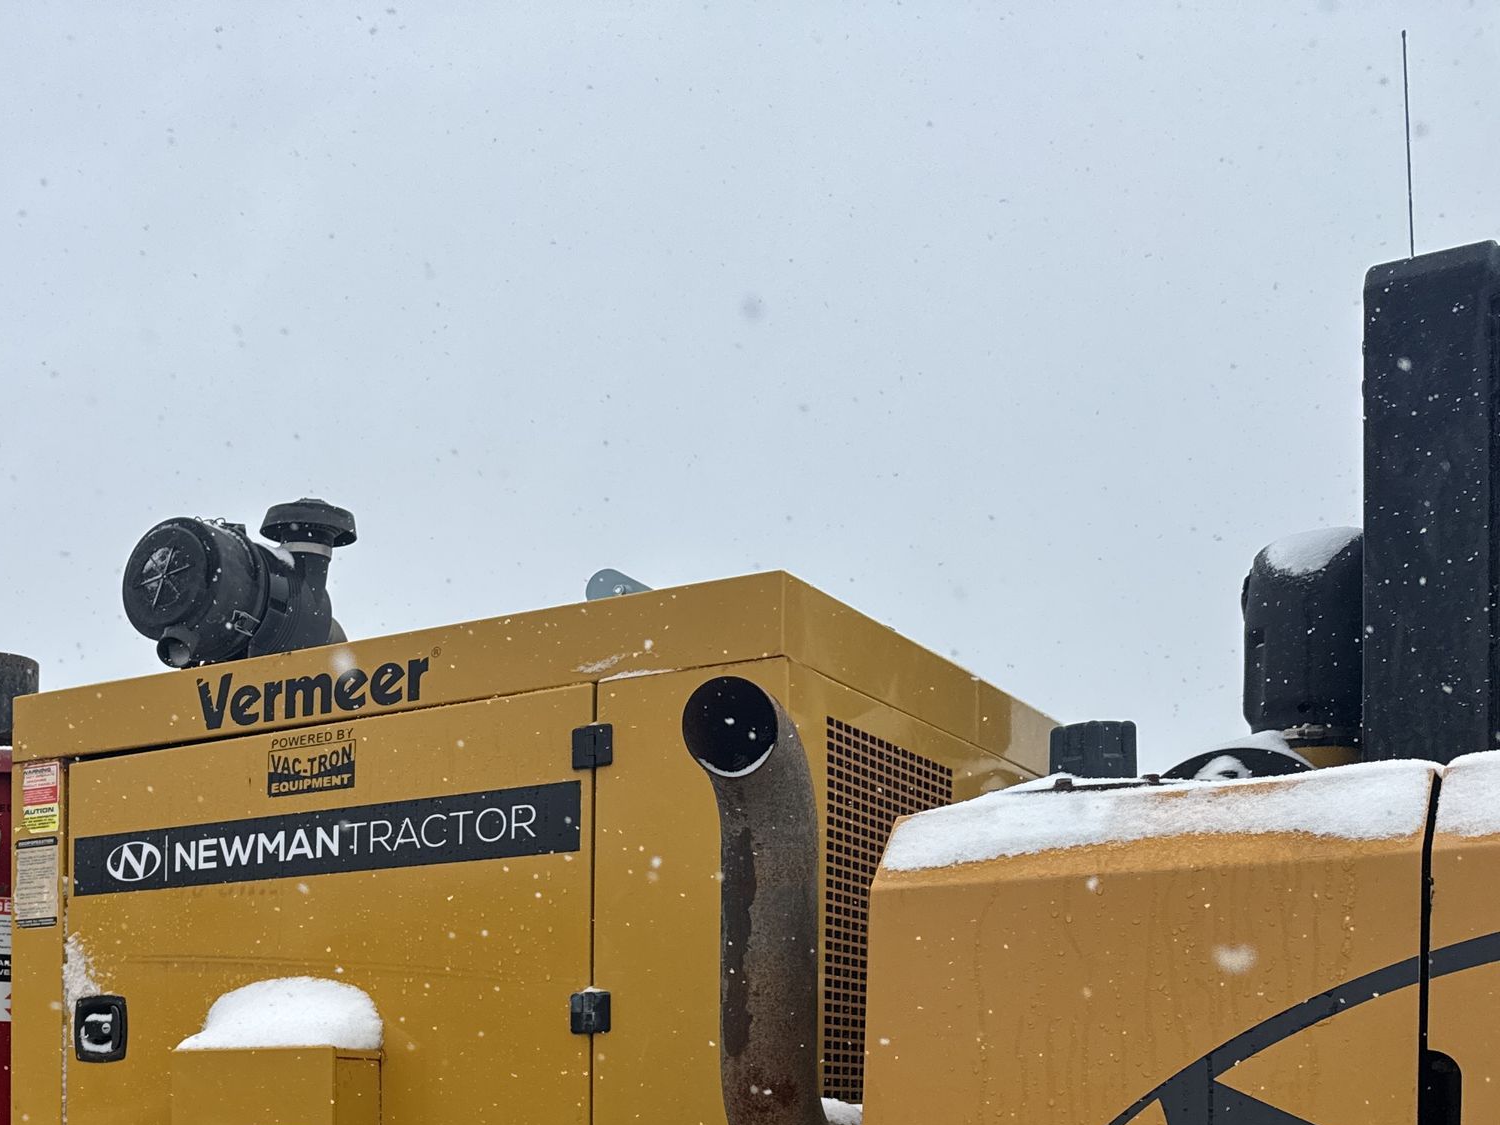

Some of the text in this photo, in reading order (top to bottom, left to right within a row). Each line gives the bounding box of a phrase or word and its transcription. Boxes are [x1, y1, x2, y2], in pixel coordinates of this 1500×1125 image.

[196, 656, 430, 731] Vermeer
[271, 727, 354, 749] POWERED BY
[270, 743, 353, 776] VAC-TRON
[271, 773, 352, 794] EQUIPMENT
